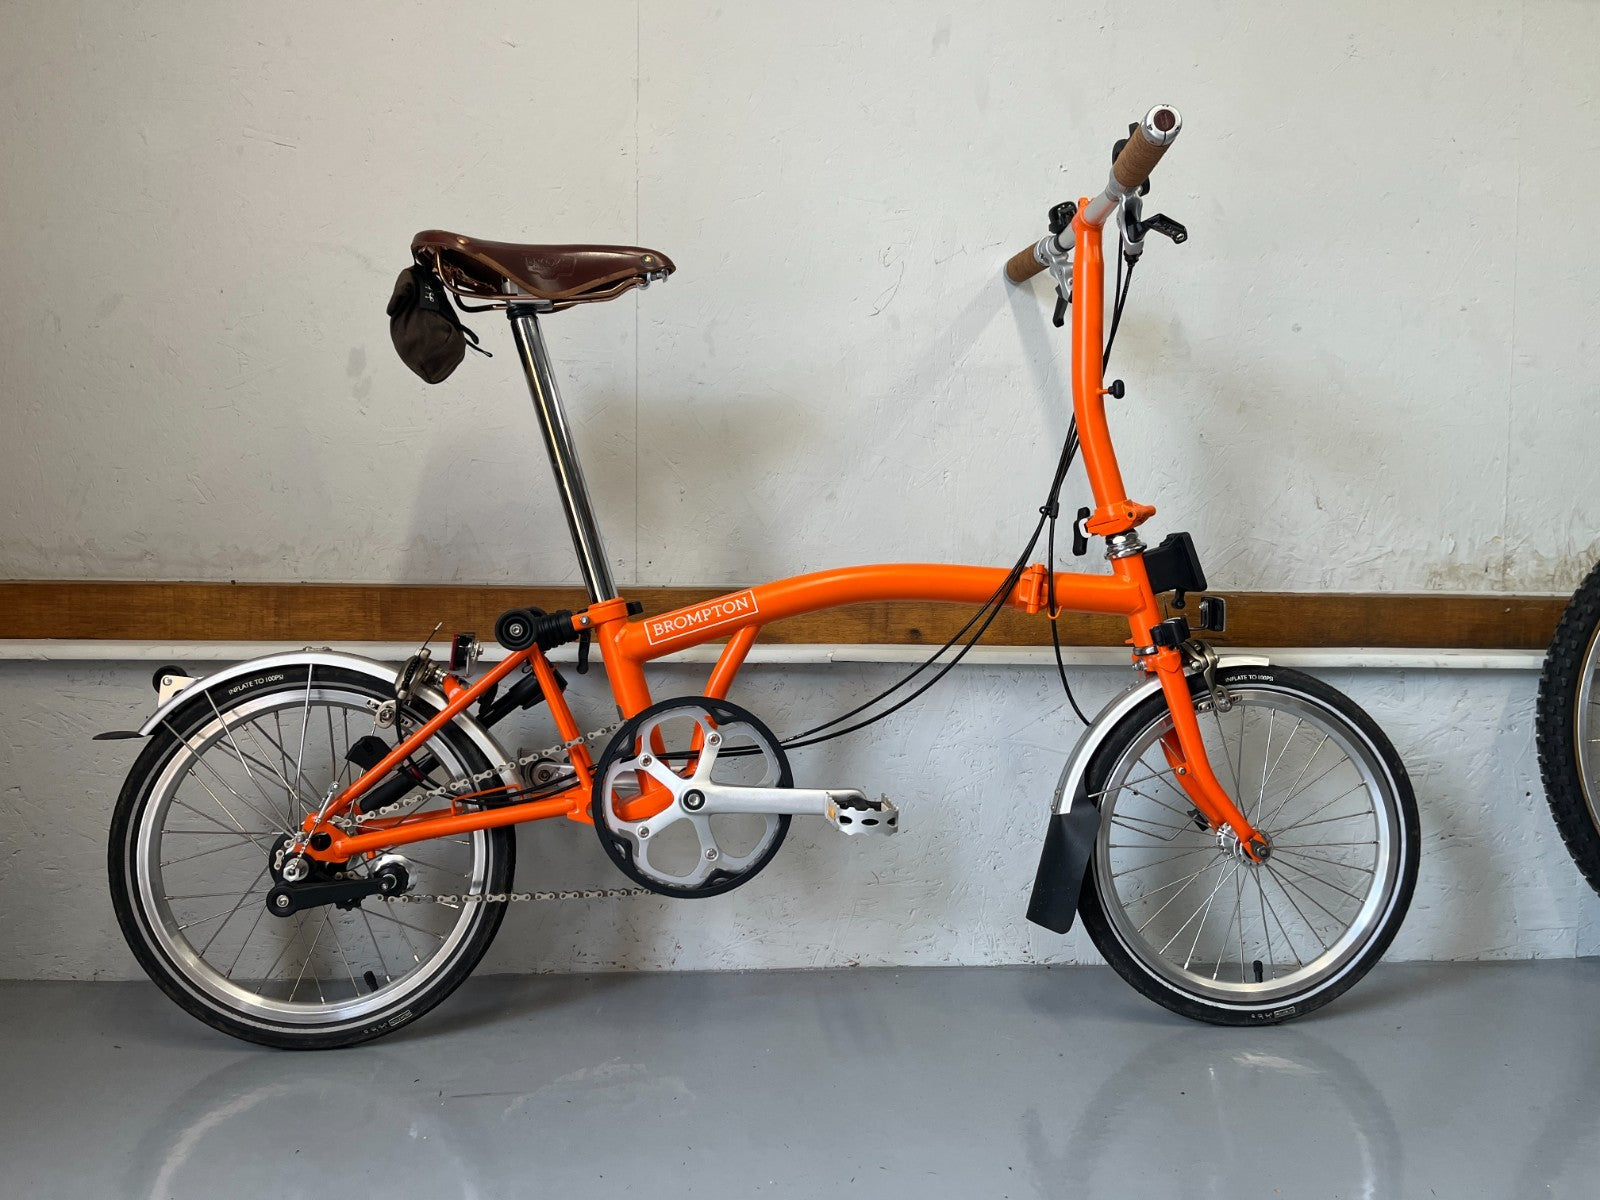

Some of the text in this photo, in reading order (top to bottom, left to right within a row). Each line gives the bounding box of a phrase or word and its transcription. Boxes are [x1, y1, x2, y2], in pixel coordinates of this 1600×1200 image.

[653, 597, 749, 636] BROMPTON
[228, 681, 254, 695] INFLATE
[254, 677, 265, 685] TO
[1225, 674, 1248, 682] INFLATE
